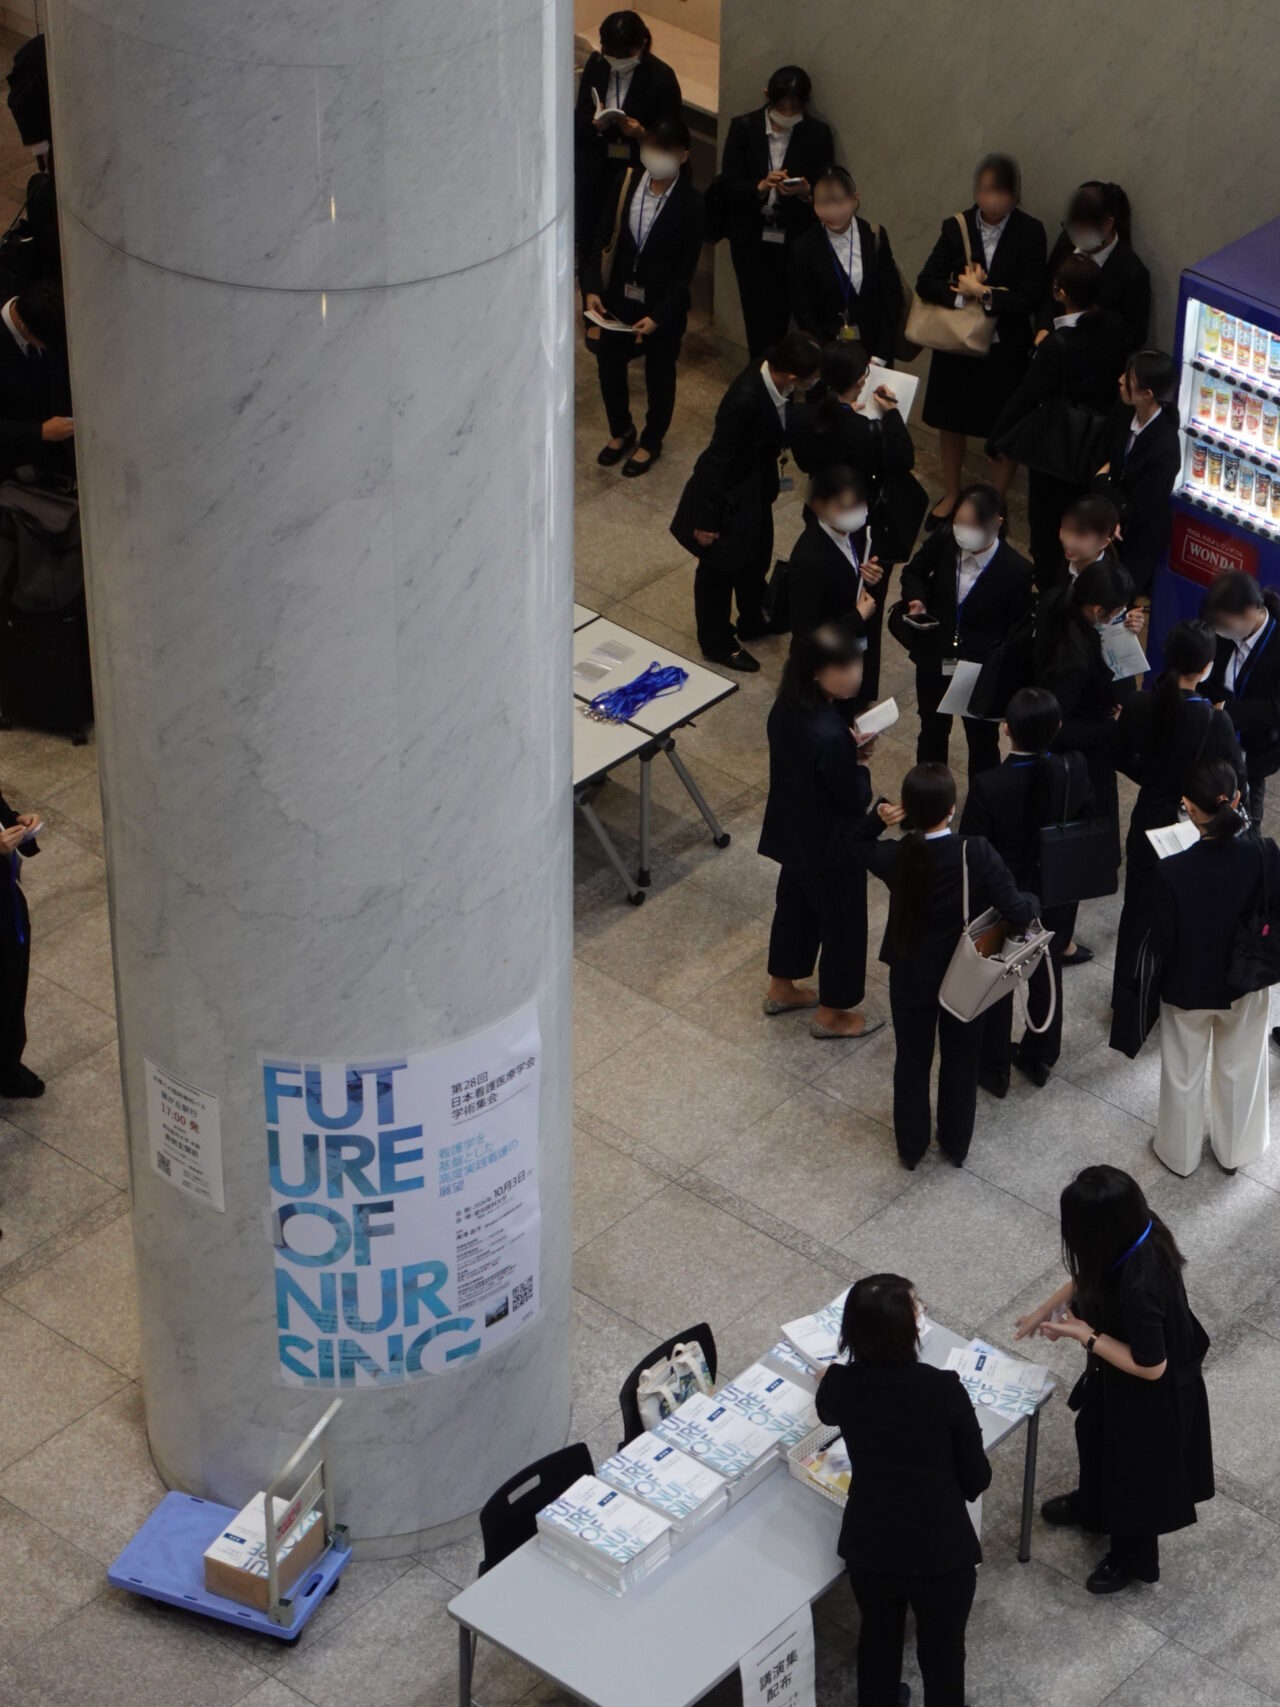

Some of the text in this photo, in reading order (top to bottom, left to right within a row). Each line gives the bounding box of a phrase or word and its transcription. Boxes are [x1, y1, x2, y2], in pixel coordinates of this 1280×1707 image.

[263, 1059, 408, 1131] FUT
[451, 1056, 537, 1108] 日本看護医療学会
[451, 1071, 489, 1096] 第28回
[451, 1092, 499, 1121] 学術集会
[266, 1123, 425, 1199] URE
[273, 1200, 396, 1268] OF
[274, 1259, 453, 1334] NUR
[278, 1316, 482, 1388] SING
